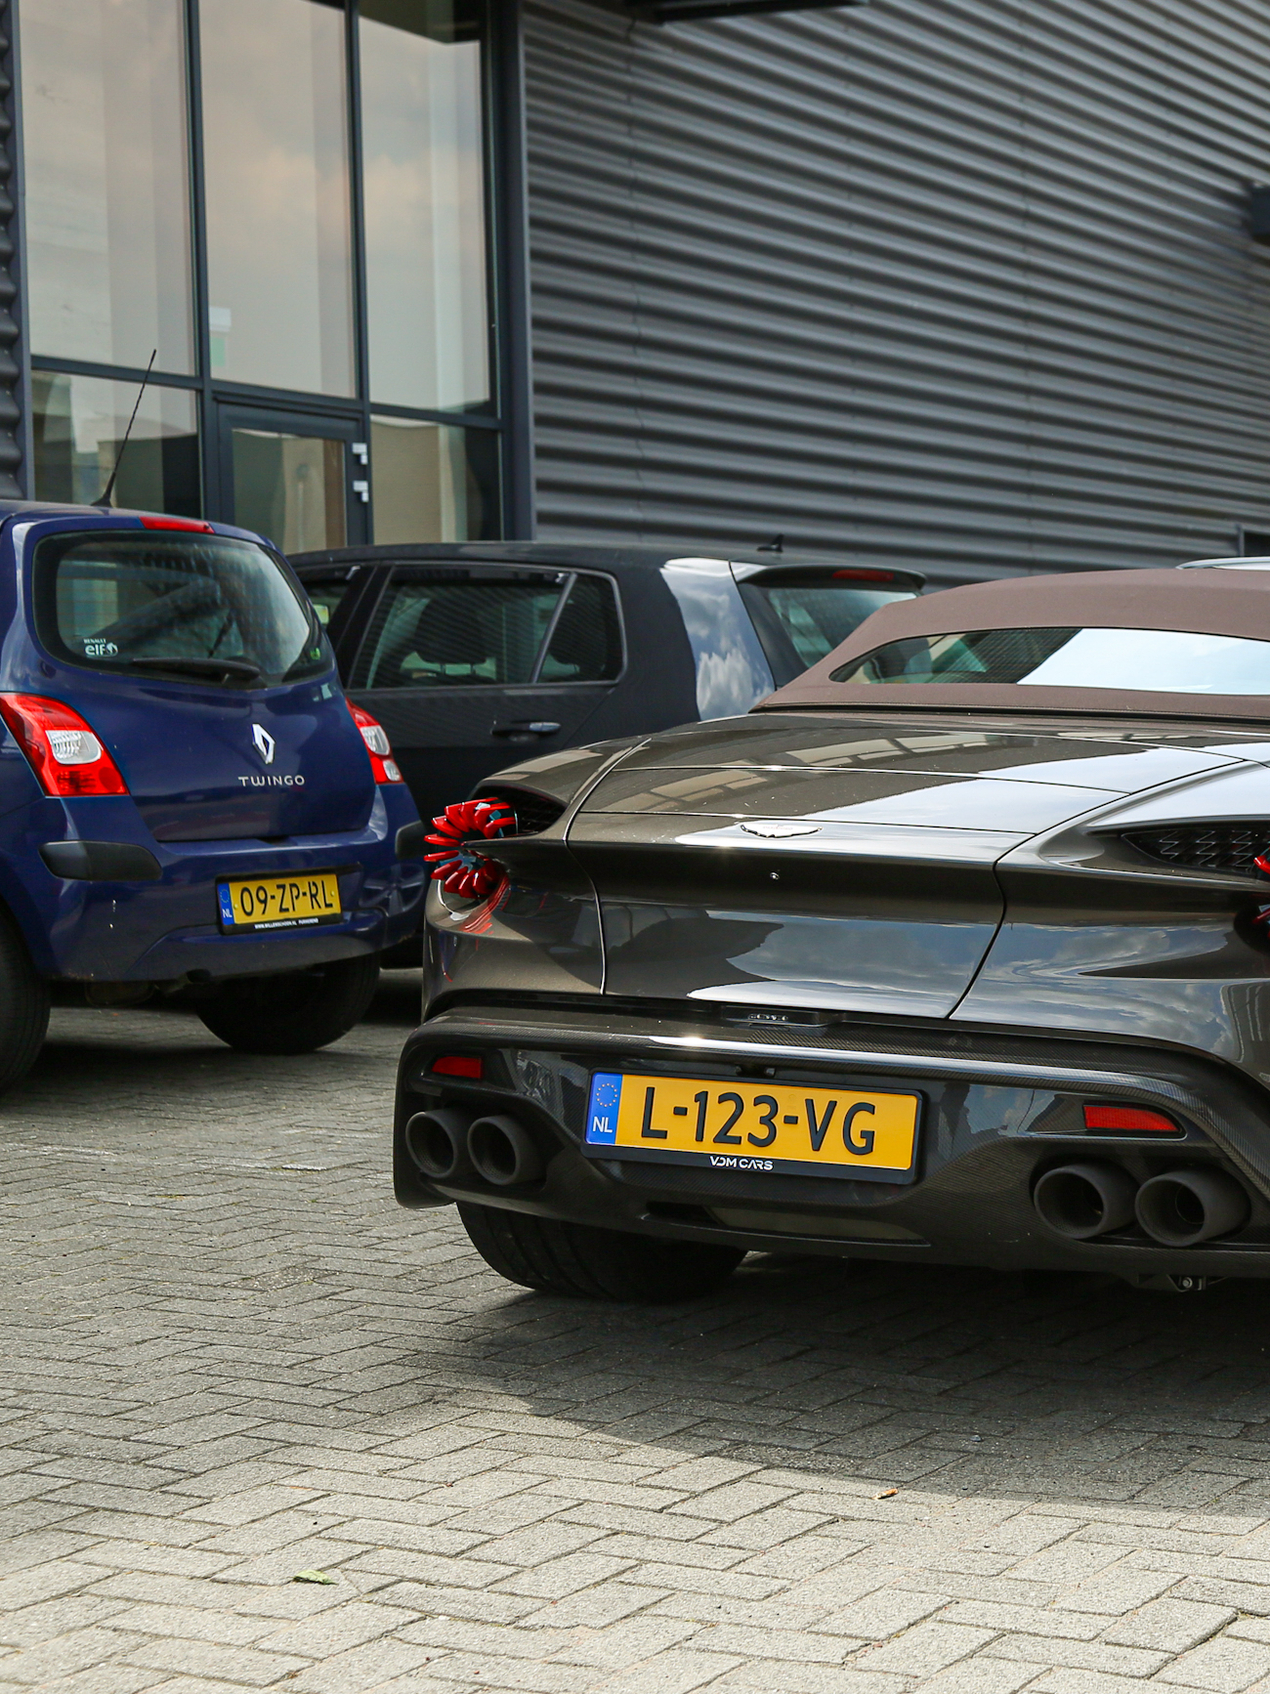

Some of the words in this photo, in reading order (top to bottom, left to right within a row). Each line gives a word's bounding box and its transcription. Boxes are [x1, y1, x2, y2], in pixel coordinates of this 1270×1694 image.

[238, 775, 305, 787] TWINGO
[240, 880, 333, 917] 09-ZP-RL
[222, 908, 232, 918] NL
[592, 1116, 613, 1133] NL
[641, 1086, 876, 1156] L-123-VG
[739, 1158, 774, 1171] CARS
